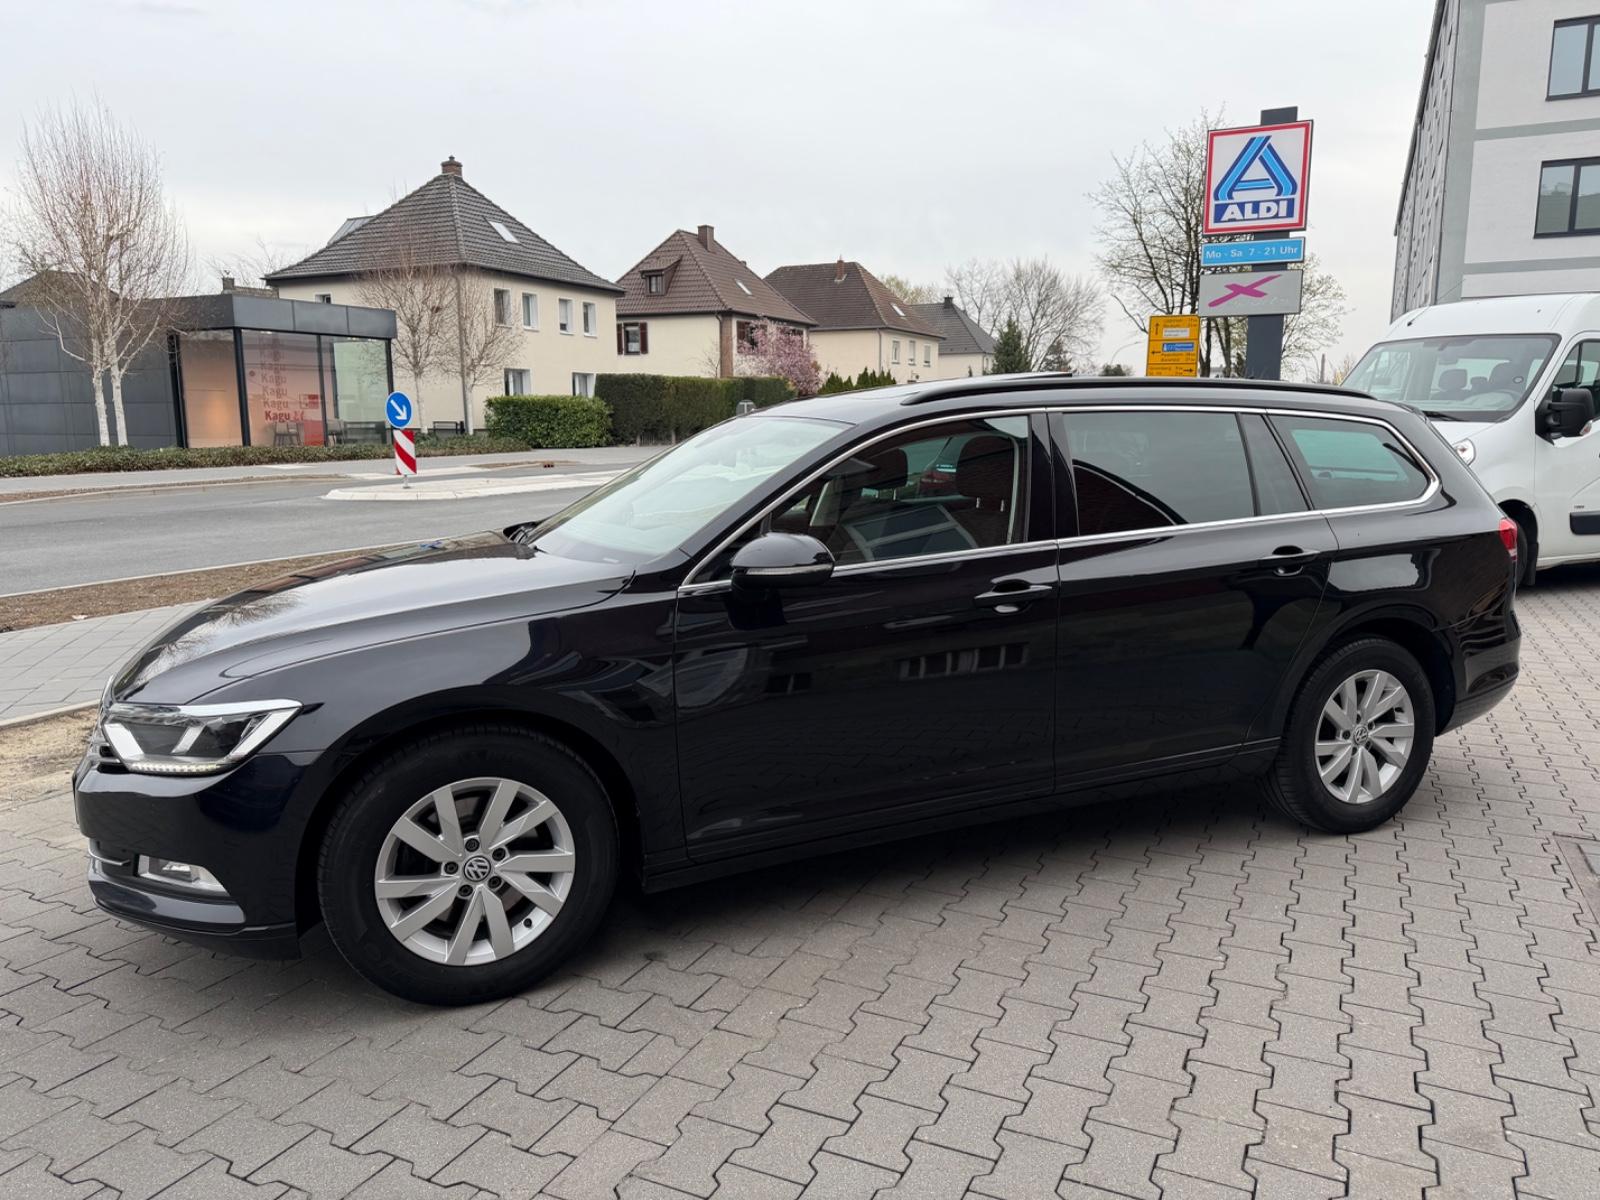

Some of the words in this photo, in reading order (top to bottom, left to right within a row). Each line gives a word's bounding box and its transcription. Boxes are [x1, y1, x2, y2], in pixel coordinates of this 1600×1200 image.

[1220, 200, 1288, 221] ALDI
[1206, 250, 1221, 259] Mo
[1230, 249, 1243, 258] Sa
[1248, 248, 1255, 256] 7
[1264, 247, 1276, 256] 21
[1280, 246, 1298, 255] Uhr
[263, 399, 289, 411] Kagu
[265, 410, 290, 423] Kagu
